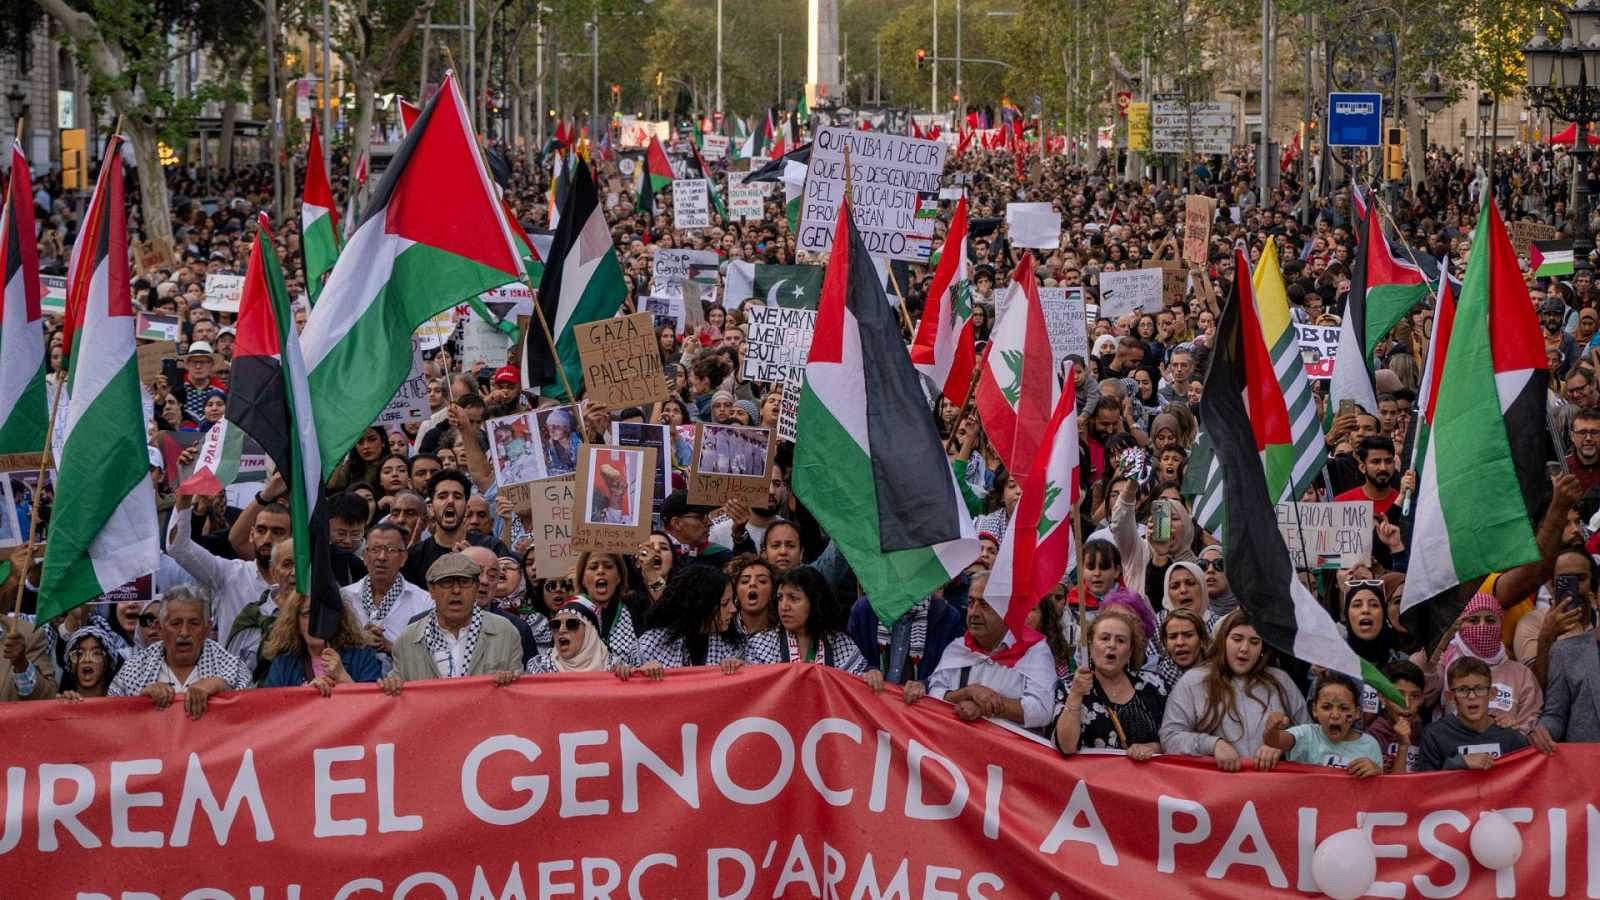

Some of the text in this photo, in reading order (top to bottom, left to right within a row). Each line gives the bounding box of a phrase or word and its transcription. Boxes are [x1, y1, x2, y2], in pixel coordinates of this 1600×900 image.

[819, 130, 939, 166] QUIÉN IBA A DECIR
[813, 159, 840, 179] QUE
[808, 180, 915, 210] DEL OLOCAUSTO
[896, 211, 915, 230] UN
[801, 226, 906, 254] GENIDIO
[751, 306, 778, 325] WE
[589, 319, 639, 345] GAZA
[745, 341, 778, 363] BUT
[1342, 504, 1368, 529] MAR
[312, 743, 424, 838] EL
[461, 716, 1004, 841] GENOCIDI
[1039, 779, 1120, 867] A
